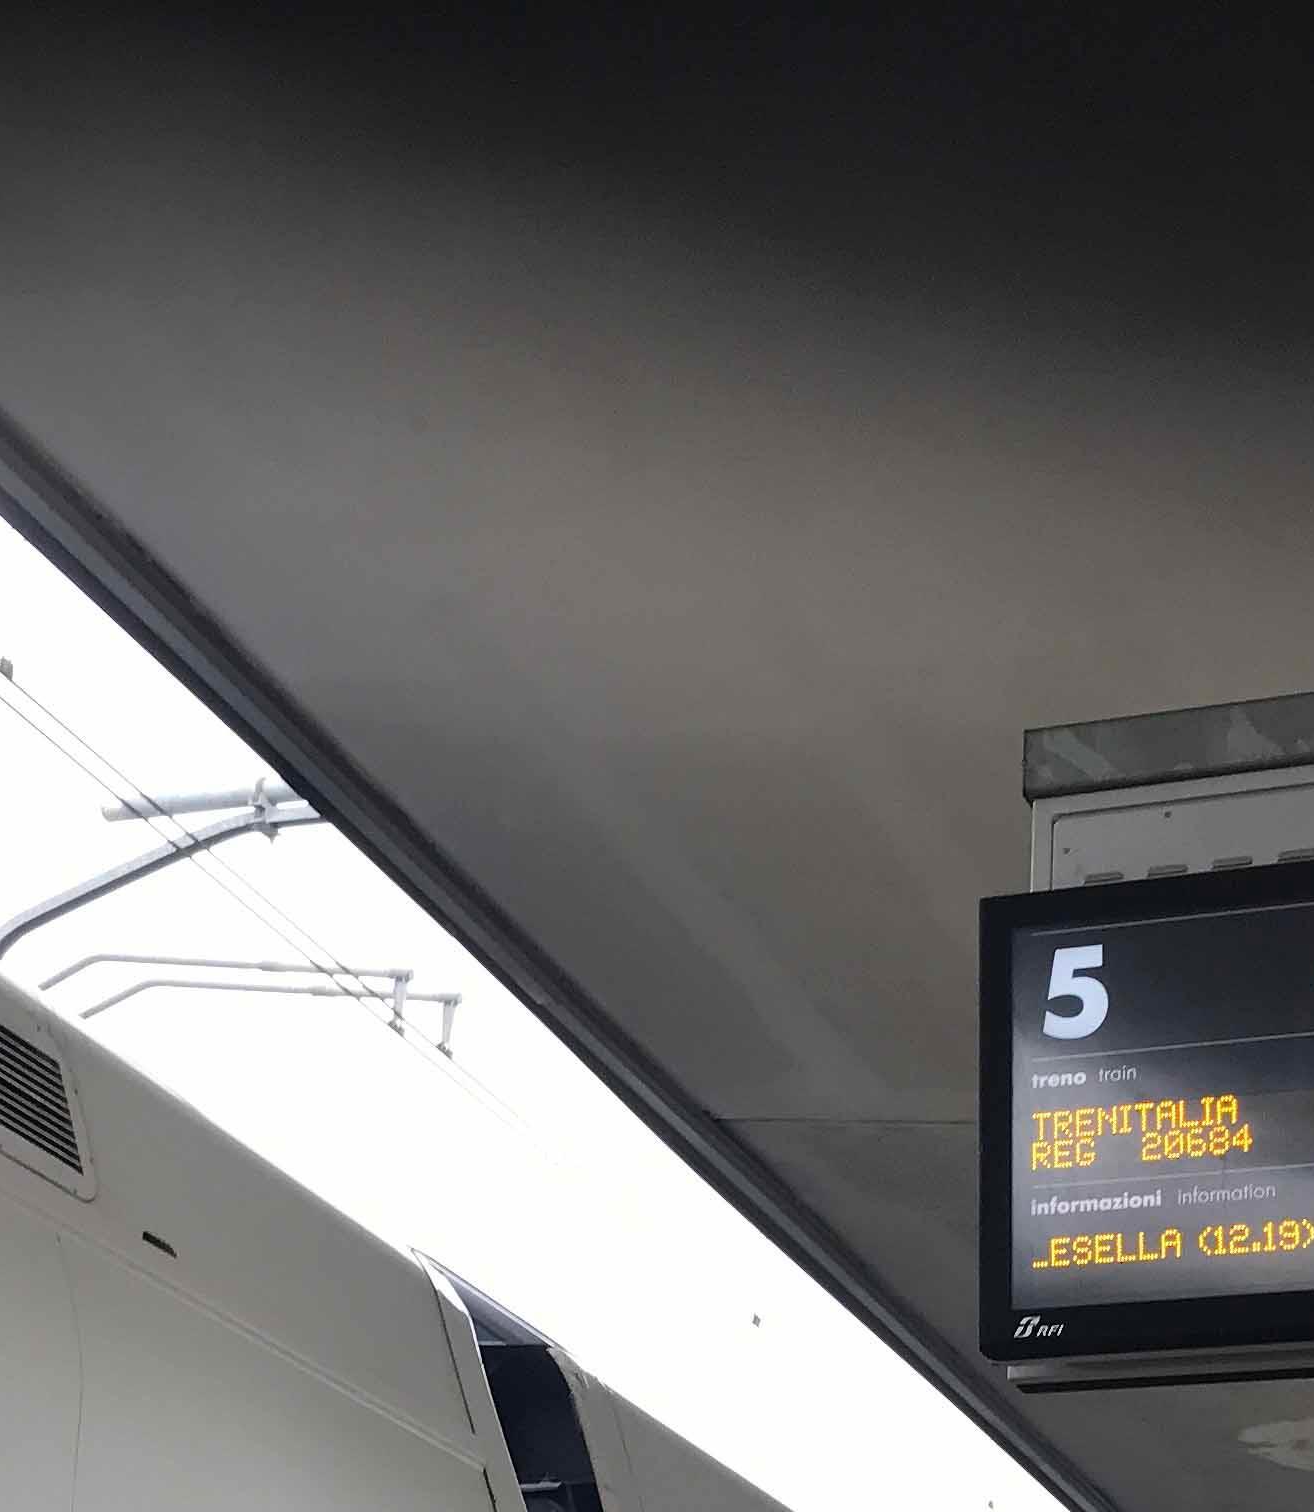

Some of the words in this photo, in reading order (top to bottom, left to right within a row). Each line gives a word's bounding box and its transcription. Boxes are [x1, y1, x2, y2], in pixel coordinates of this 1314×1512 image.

[1043, 944, 1108, 1040] 5
[1031, 1071, 1087, 1088] treno
[1098, 1064, 1137, 1082] train
[1032, 1094, 1238, 1139] TRENITALIA
[1032, 1138, 1096, 1170] REG
[1141, 1124, 1253, 1162] 20684
[1030, 1189, 1162, 1217] informazioni
[1178, 1183, 1276, 1205] information
[1036, 1323, 1064, 1338] RFI
